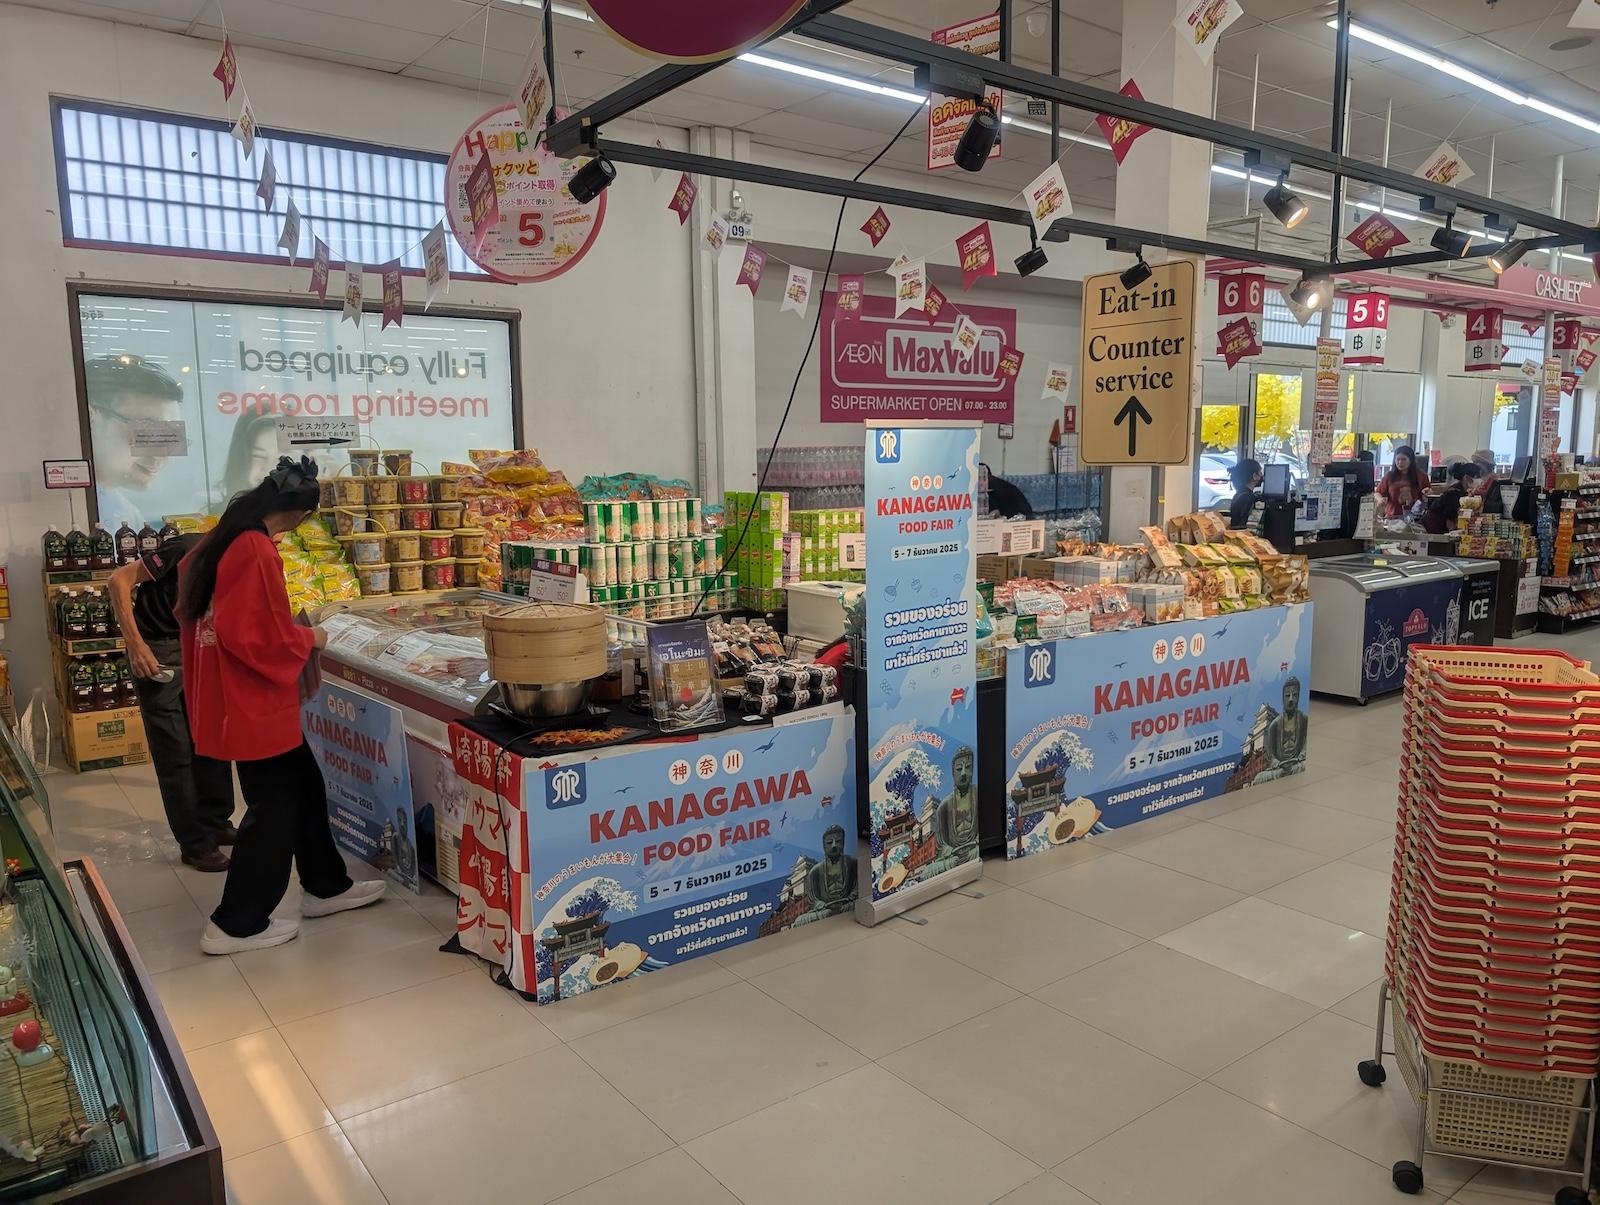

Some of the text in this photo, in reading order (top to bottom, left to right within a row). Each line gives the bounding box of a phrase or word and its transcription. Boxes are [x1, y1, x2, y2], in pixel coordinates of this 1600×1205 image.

[519, 212, 546, 248] 5
[731, 224, 745, 237] 09
[1098, 282, 1177, 316] Eat-in
[1224, 281, 1239, 307] 6
[1250, 280, 1260, 306] 6
[1536, 273, 1581, 303] CASHIER
[1352, 298, 1368, 323] 5
[1376, 298, 1386, 322] 5
[1471, 314, 1487, 335] 4
[1088, 334, 1185, 362] Counter
[1554, 326, 1567, 344] 3
[893, 336, 995, 376] MaxValu
[1095, 365, 1174, 394] service
[831, 395, 927, 411] SUPERMARKET
[929, 397, 962, 411] OPEN
[965, 401, 983, 410] 07.00
[989, 401, 1007, 410] 23.00
[278, 422, 356, 431] サービスカウンター
[911, 477, 942, 490] 神奈川
[877, 493, 972, 516] KANAGAWA
[899, 518, 953, 534] FOOD FAIR
[894, 550, 899, 558] 5
[907, 548, 911, 557] 7
[940, 544, 958, 553] 2025
[1468, 598, 1489, 620] ICE
[1154, 636, 1204, 661] 神奈川
[1093, 657, 1250, 715] KANAGAWA
[1130, 703, 1219, 741] FOOD FAIR
[305, 710, 388, 768] KANAGAWA
[1129, 757, 1136, 769] 5
[1148, 753, 1154, 764] 7
[1194, 736, 1219, 752] 2025
[324, 748, 373, 785] FOOD FAIR
[456, 732, 512, 788] 崎陽軒
[671, 752, 741, 781] 神奈川
[589, 769, 813, 845] KANAGAWA
[643, 818, 771, 866] FOOD FAIR
[650, 886, 659, 898] 5
[674, 880, 682, 892] 7
[686, 871, 731, 889] ธันวาคม
[735, 858, 767, 876] 2025
[673, 891, 748, 920] รวมของอร่อย
[647, 902, 773, 945] จากจังหวัดคานางาวะ
